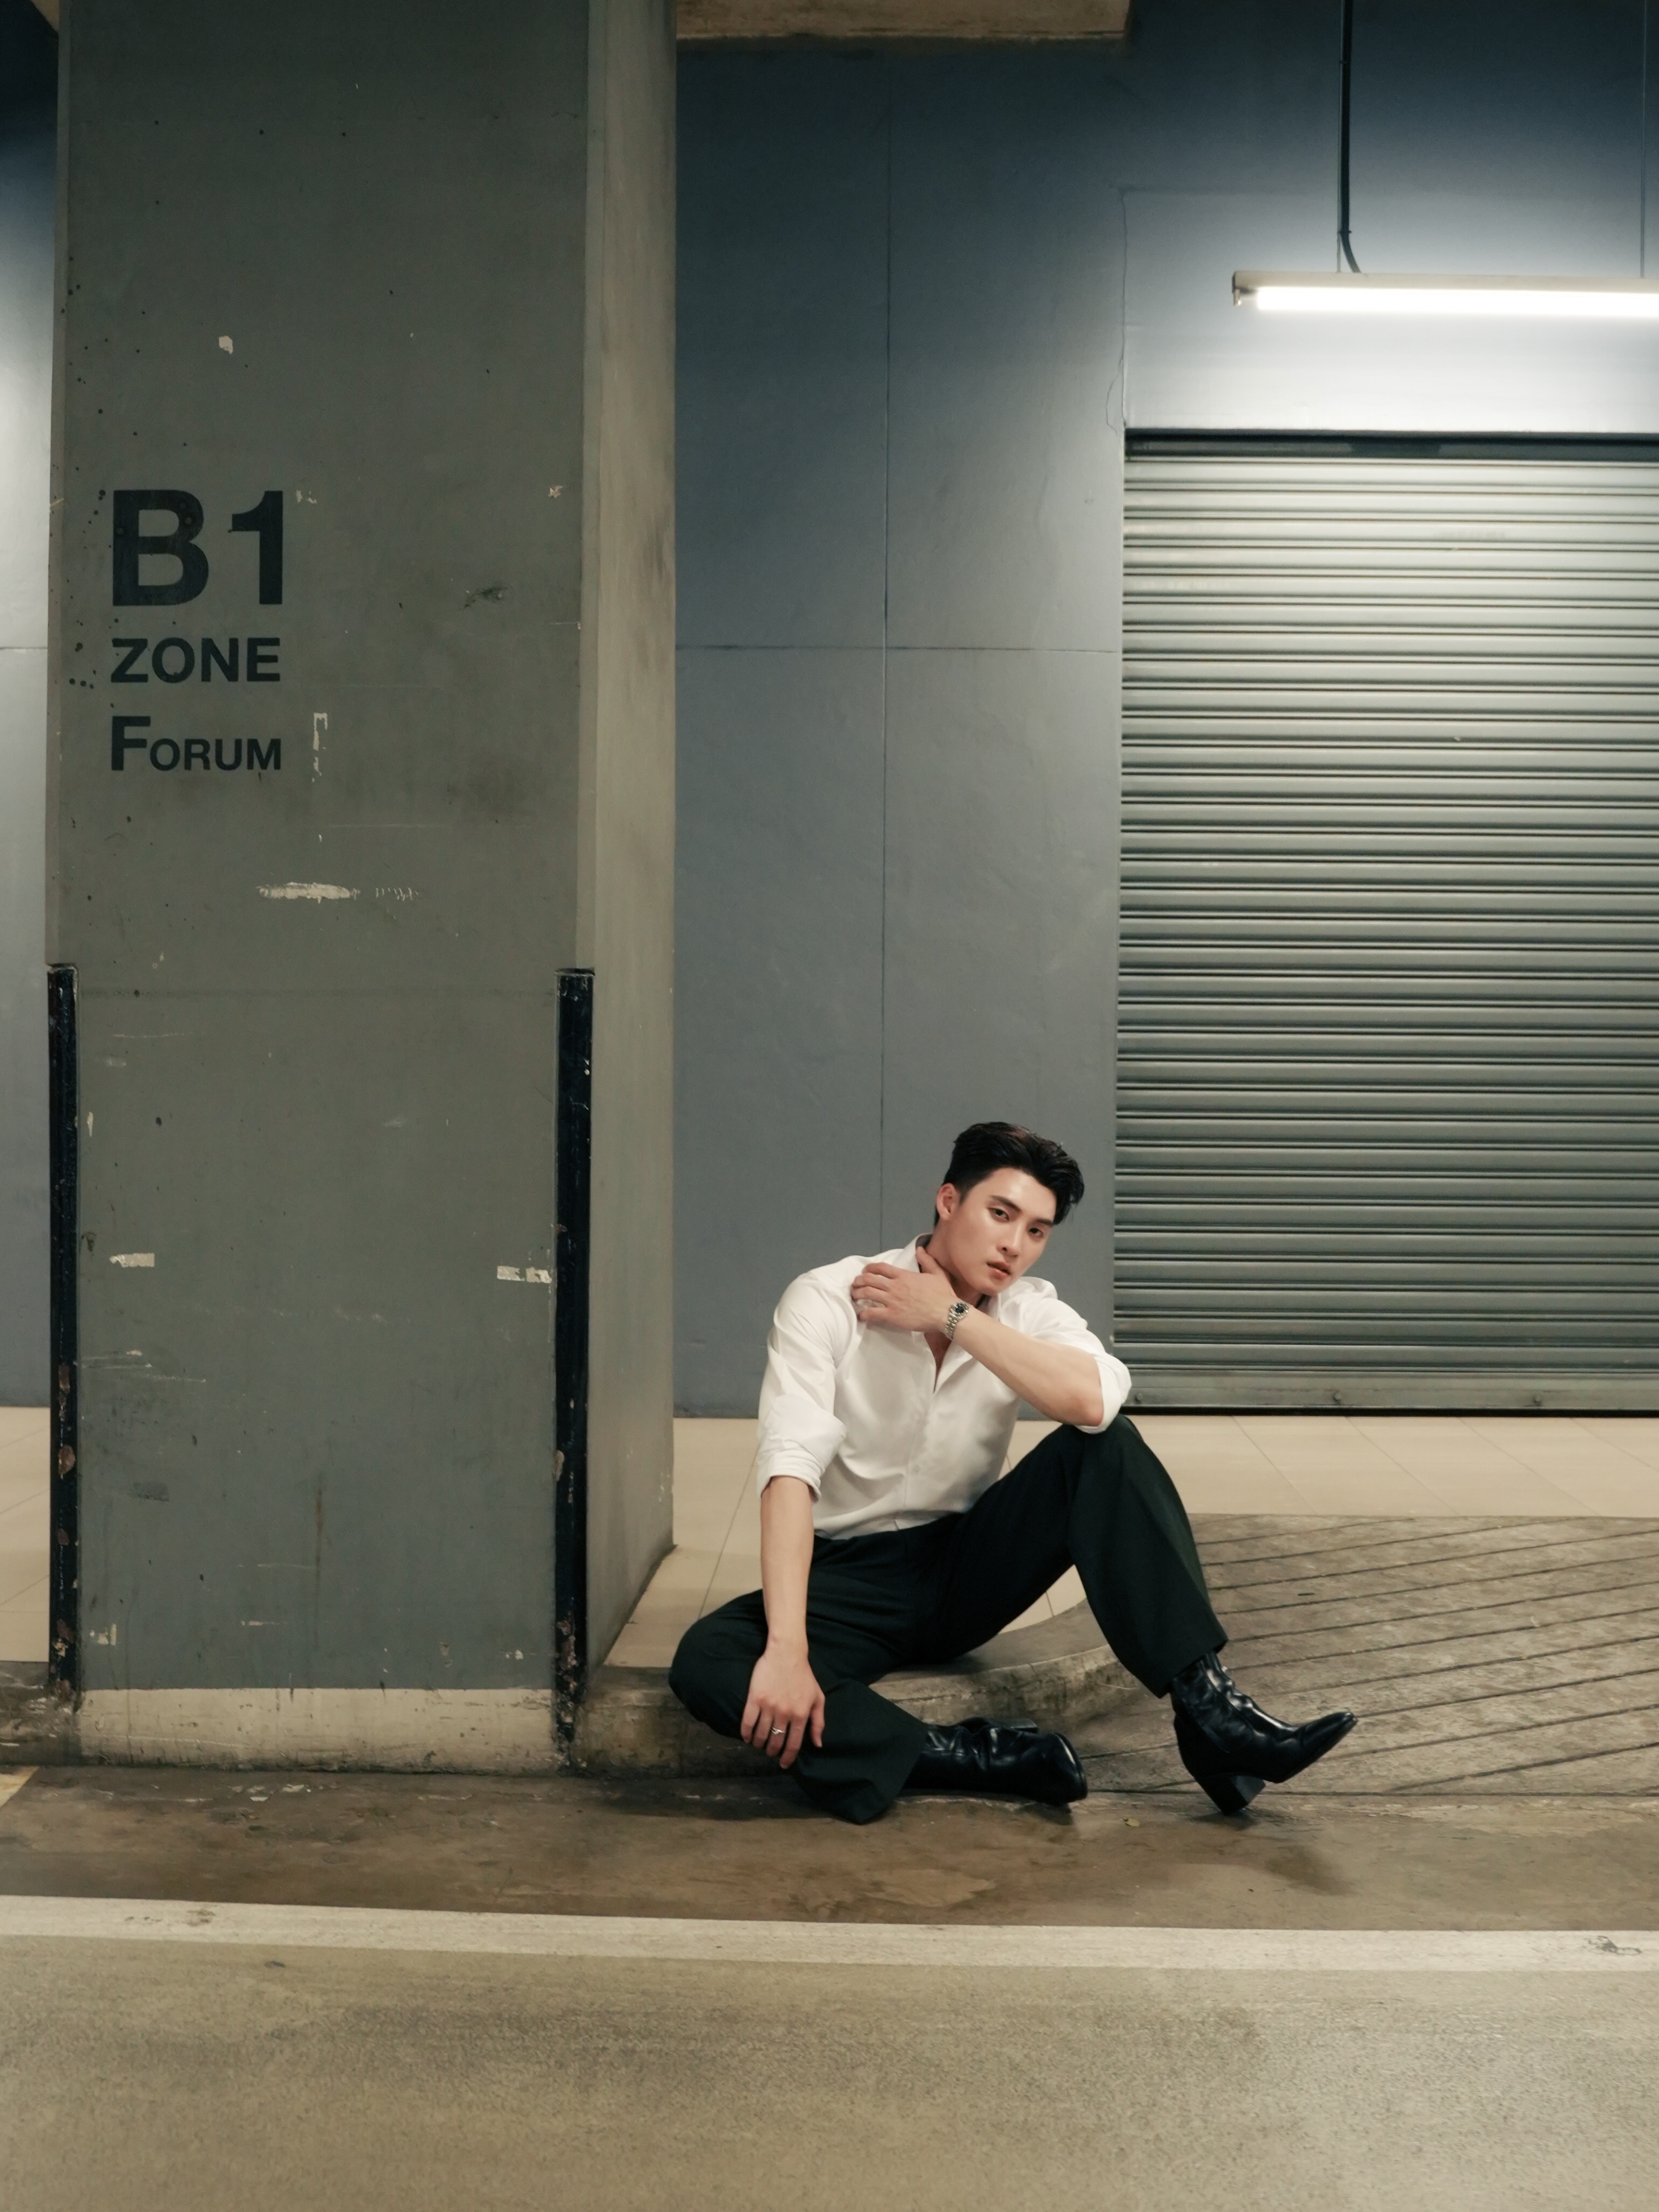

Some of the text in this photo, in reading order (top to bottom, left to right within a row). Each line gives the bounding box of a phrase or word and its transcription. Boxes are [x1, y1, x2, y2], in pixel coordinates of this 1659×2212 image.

[112, 489, 284, 606] B1
[110, 637, 281, 683] ZONE
[111, 716, 281, 771] FORUM
